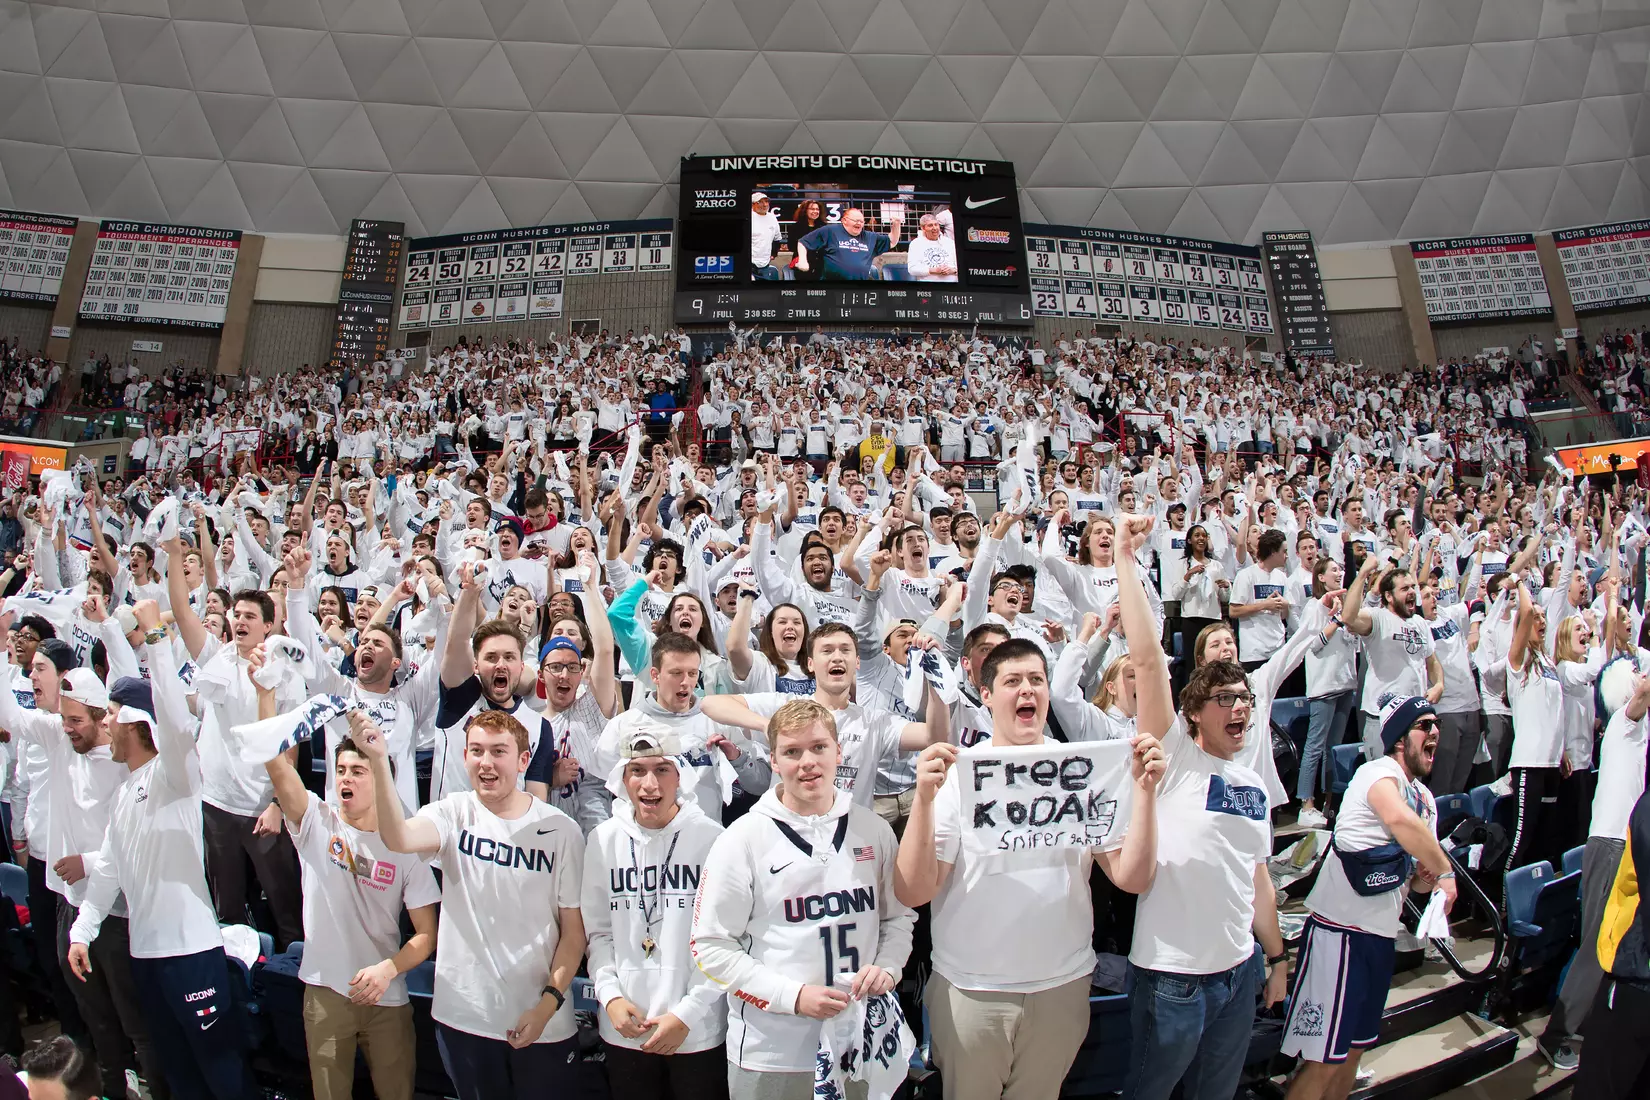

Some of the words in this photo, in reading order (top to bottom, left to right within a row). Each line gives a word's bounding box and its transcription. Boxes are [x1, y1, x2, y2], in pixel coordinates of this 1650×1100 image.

[711, 156, 823, 171] UNIVERSITY
[829, 156, 852, 168] OF
[858, 156, 986, 174] CONNECTICUT
[695, 190, 736, 198] WELLS
[695, 200, 736, 208] FARGO
[11, 214, 37, 222] ATHLETIC
[38, 217, 75, 225] CONFERENCE
[15, 223, 63, 233] CHAMPIONS
[108, 223, 139, 232] NCAA
[144, 225, 233, 238] CHAMPIONSHIP
[463, 232, 497, 242] UCONN
[503, 227, 549, 238] HUSKIES
[553, 226, 569, 234] OF
[573, 224, 610, 233] HONOR
[1560, 230, 1585, 239] NCAA
[37, 234, 50, 244] 1997
[105, 232, 163, 241] TOURNAMENT
[168, 237, 232, 247] APPEARANCES
[1081, 230, 1114, 238] UCONN
[1120, 233, 1161, 243] HUSKIES
[1183, 240, 1213, 249] HONOR
[1418, 242, 1446, 251] NCAA
[1451, 235, 1527, 248] CHAMPIONSHIP
[650, 249, 661, 263] 10
[1475, 246, 1507, 254] SIXTEEN
[505, 258, 526, 272] 52
[539, 255, 561, 270] 42
[576, 253, 592, 267] 25
[613, 251, 626, 265] 33
[695, 256, 730, 266] CBS
[1037, 253, 1050, 268] 32
[1072, 256, 1080, 270] 3
[408, 267, 429, 282] 24
[439, 264, 460, 278] 50
[473, 260, 492, 275] 21
[1133, 261, 1146, 275] 20
[1163, 264, 1174, 278] 31
[1191, 267, 1204, 281] 23
[1218, 270, 1232, 285] 31
[1246, 273, 1258, 287] 14
[11, 292, 57, 302] BASKETBALL
[842, 292, 877, 305] 11:12
[1037, 294, 1057, 310] 23
[1076, 296, 1086, 311] 4
[693, 299, 703, 314] 9
[1104, 298, 1122, 313] 30
[1140, 300, 1150, 315] 3
[1166, 303, 1183, 318] CD
[1575, 301, 1616, 311] CONNECTICUT
[1619, 298, 1646, 307] WOMEN'S
[81, 313, 131, 322] CONNECTICUT
[171, 319, 219, 328] BASKETBALL
[745, 310, 749, 318] 3
[788, 309, 794, 318] 2
[964, 312, 968, 320] 3
[1197, 306, 1210, 321] 15
[1222, 309, 1242, 324] 24
[1250, 312, 1269, 326] 33
[1429, 313, 1475, 322] CONNECTICUT
[1512, 308, 1552, 316] BASKETBALL
[12, 461, 24, 489] Cola
[973, 756, 1094, 791] Free
[1516, 817, 1524, 830] LAND
[998, 830, 1066, 851] Sniper
[459, 829, 555, 874] UCONN
[379, 869, 391, 877] DD
[611, 864, 700, 893] UCONN
[784, 886, 876, 923] UCONN
[820, 923, 860, 986] 15
[184, 986, 216, 1003] UCONN
[1293, 1027, 1323, 1036] Huskies
